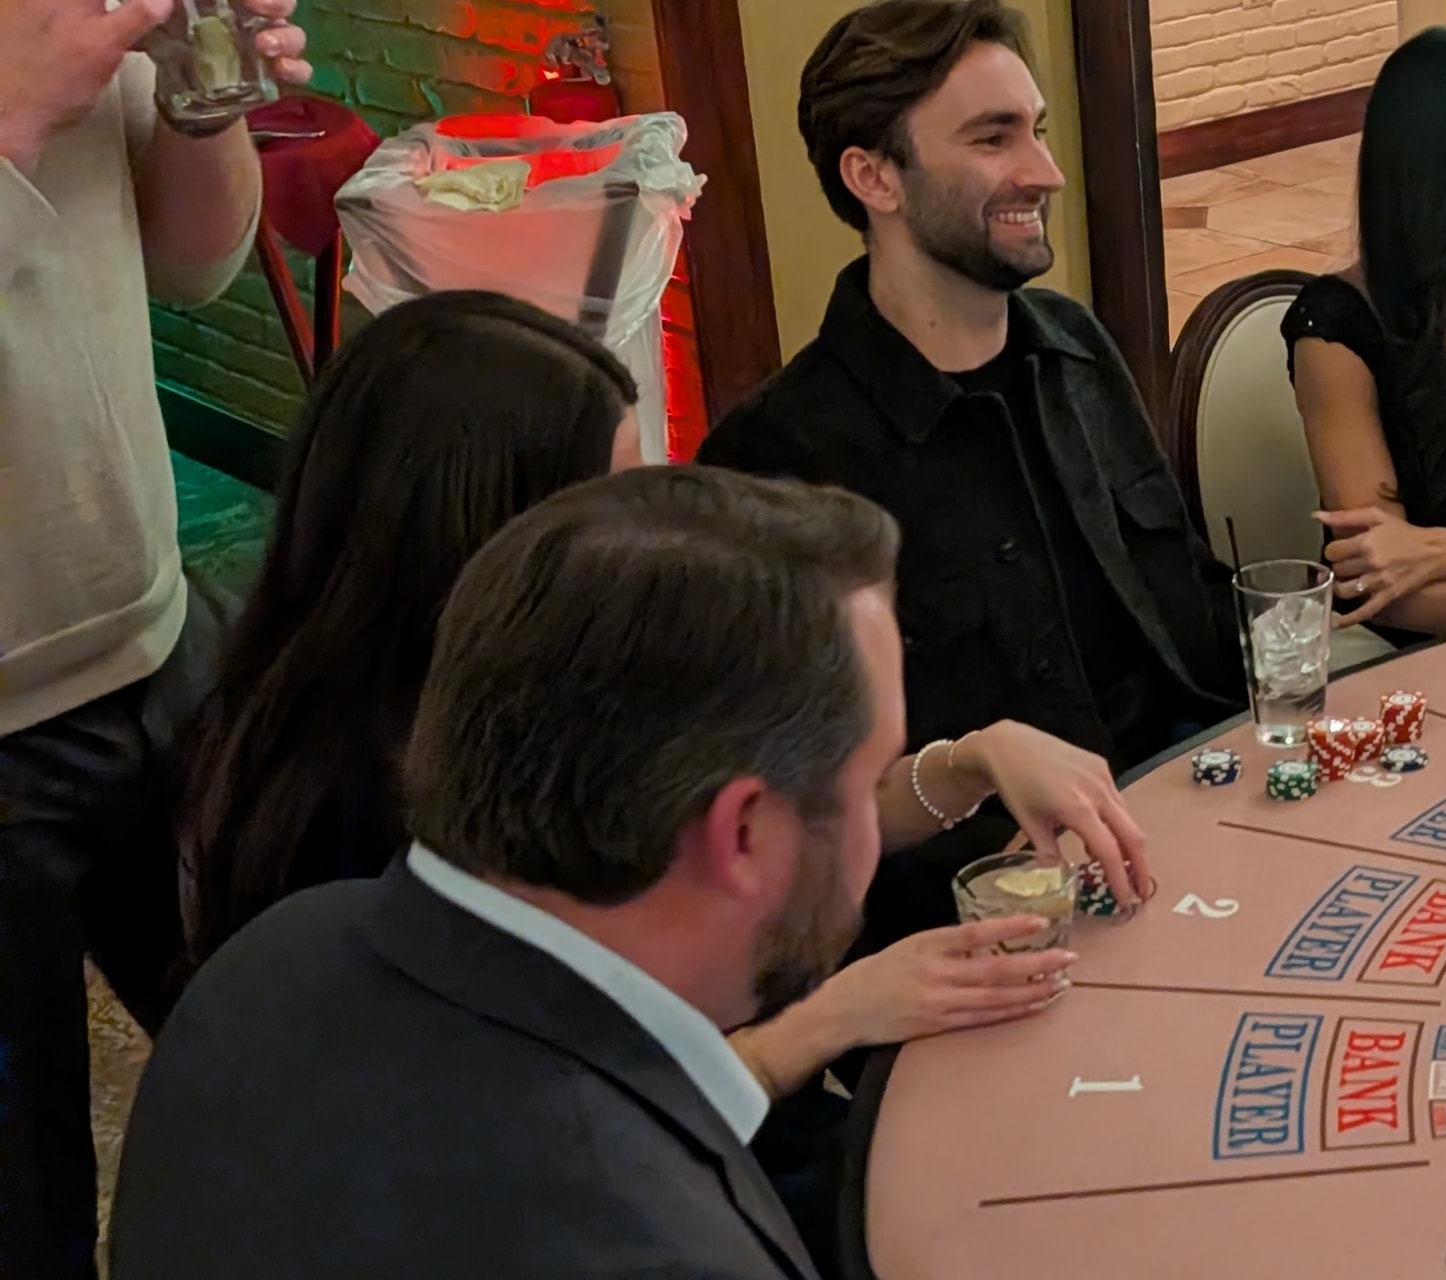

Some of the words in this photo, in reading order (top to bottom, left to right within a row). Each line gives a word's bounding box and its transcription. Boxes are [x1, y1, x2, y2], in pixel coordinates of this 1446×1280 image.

[1173, 893, 1240, 918] 2
[1280, 873, 1402, 974] PLAYER
[1069, 1075, 1143, 1097] 1
[1226, 1021, 1308, 1149] PLAYER
[1337, 1030, 1407, 1133] BANK
